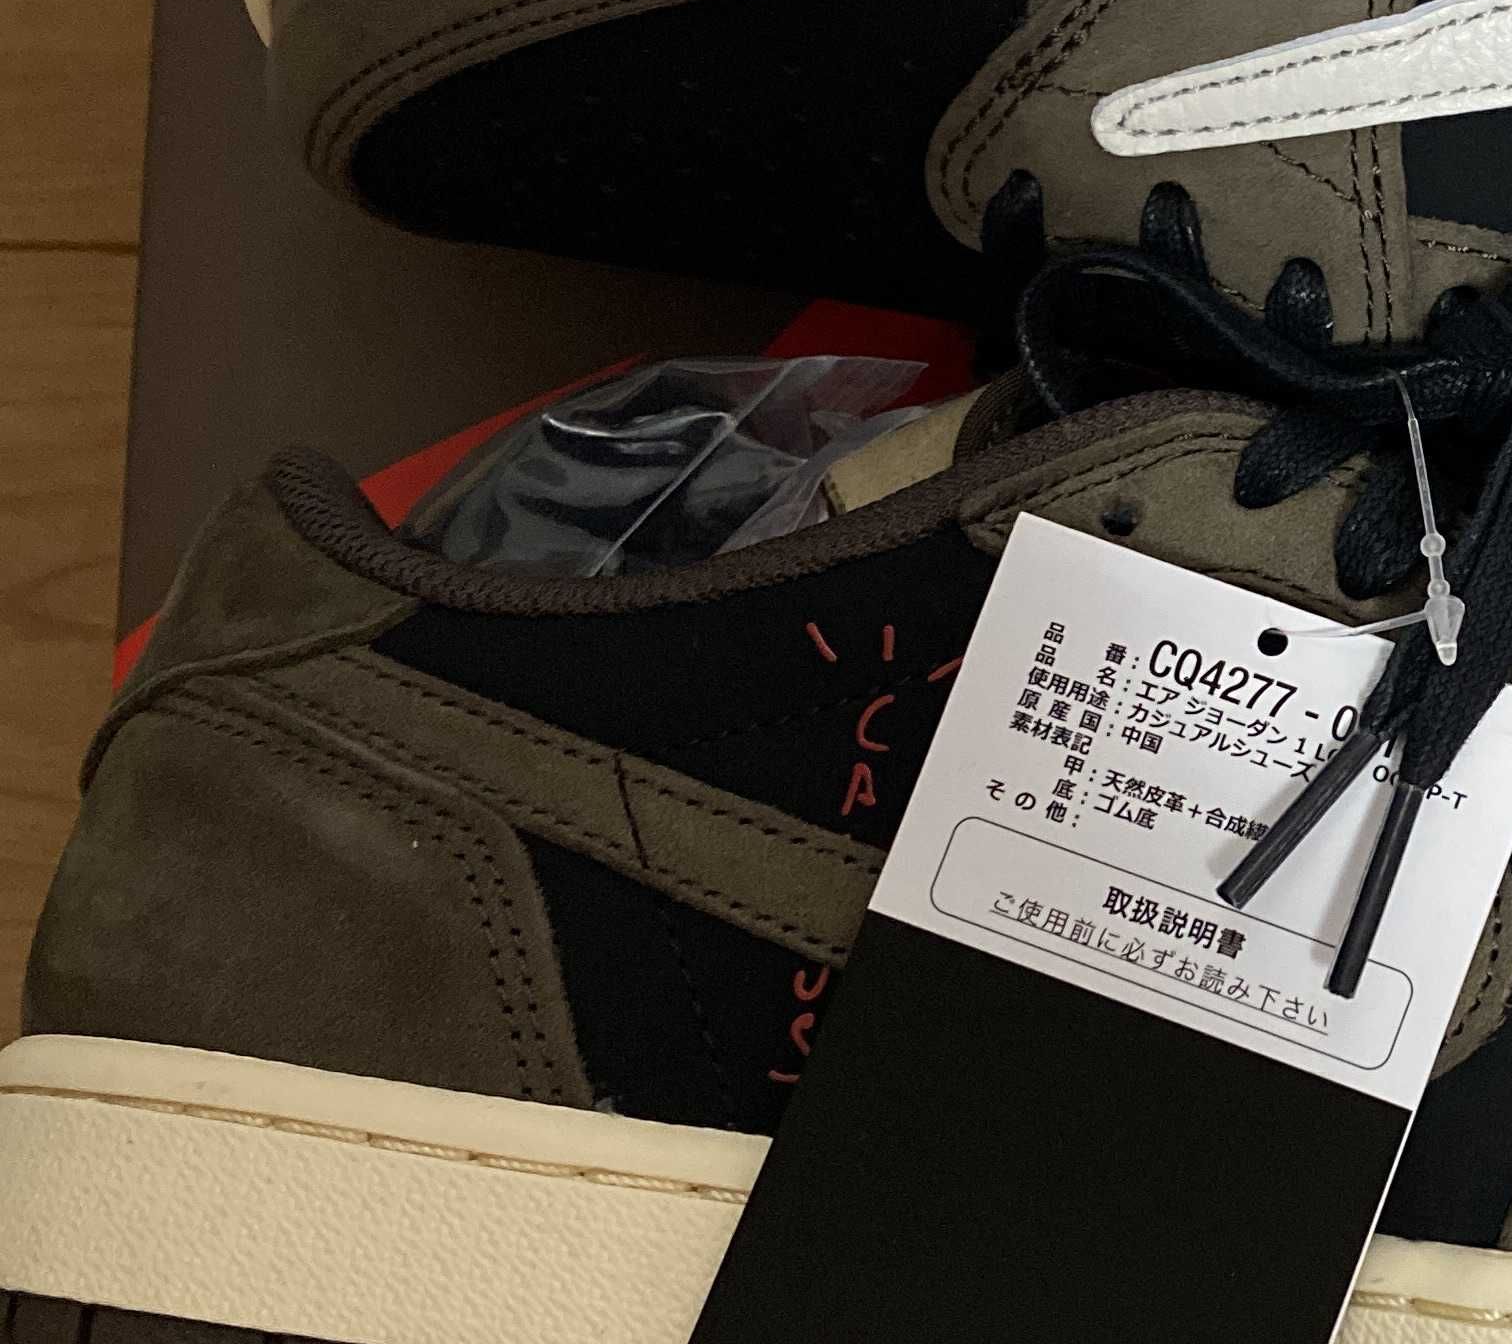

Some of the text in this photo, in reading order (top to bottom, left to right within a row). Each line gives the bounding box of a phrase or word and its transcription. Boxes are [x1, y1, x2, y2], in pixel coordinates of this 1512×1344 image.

[1008, 709, 1094, 756] 素材表記
[1120, 725, 1164, 755] 中国
[1102, 885, 1248, 960] 取扱説明書
[989, 891, 1329, 1028] ご使用前に必ずお読み下さい
